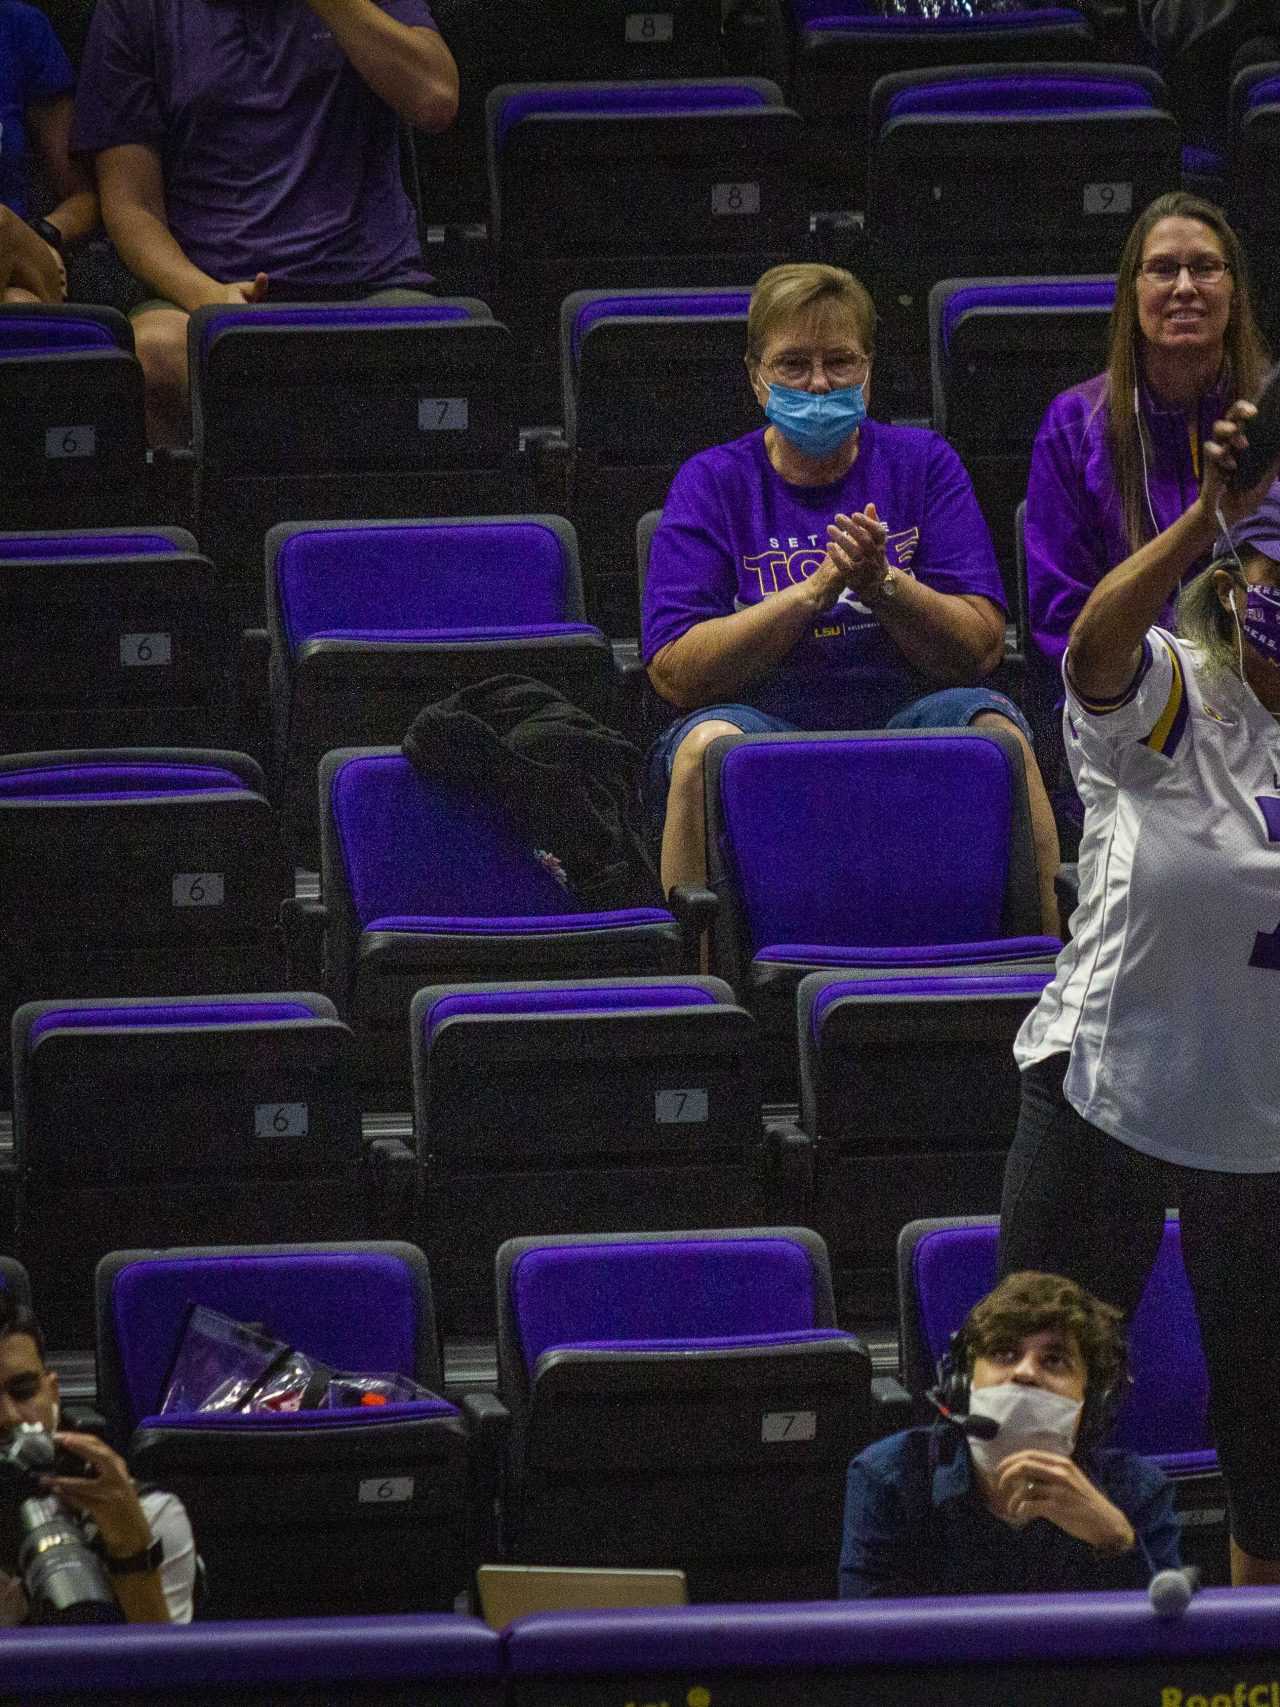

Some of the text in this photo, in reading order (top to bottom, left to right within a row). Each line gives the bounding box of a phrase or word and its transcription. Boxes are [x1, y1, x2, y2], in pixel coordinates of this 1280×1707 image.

[642, 17, 655, 38] 8
[728, 187, 742, 209] 8
[1100, 187, 1114, 209] 9
[437, 400, 448, 424] 7
[63, 429, 77, 453] 6
[768, 534, 819, 549] SET
[814, 625, 841, 638] LSU
[137, 637, 152, 661] 6
[190, 876, 205, 901] 6
[674, 1092, 688, 1118] 7
[273, 1105, 289, 1132] 6
[783, 1415, 796, 1437] 7
[377, 1480, 393, 1499] 6
